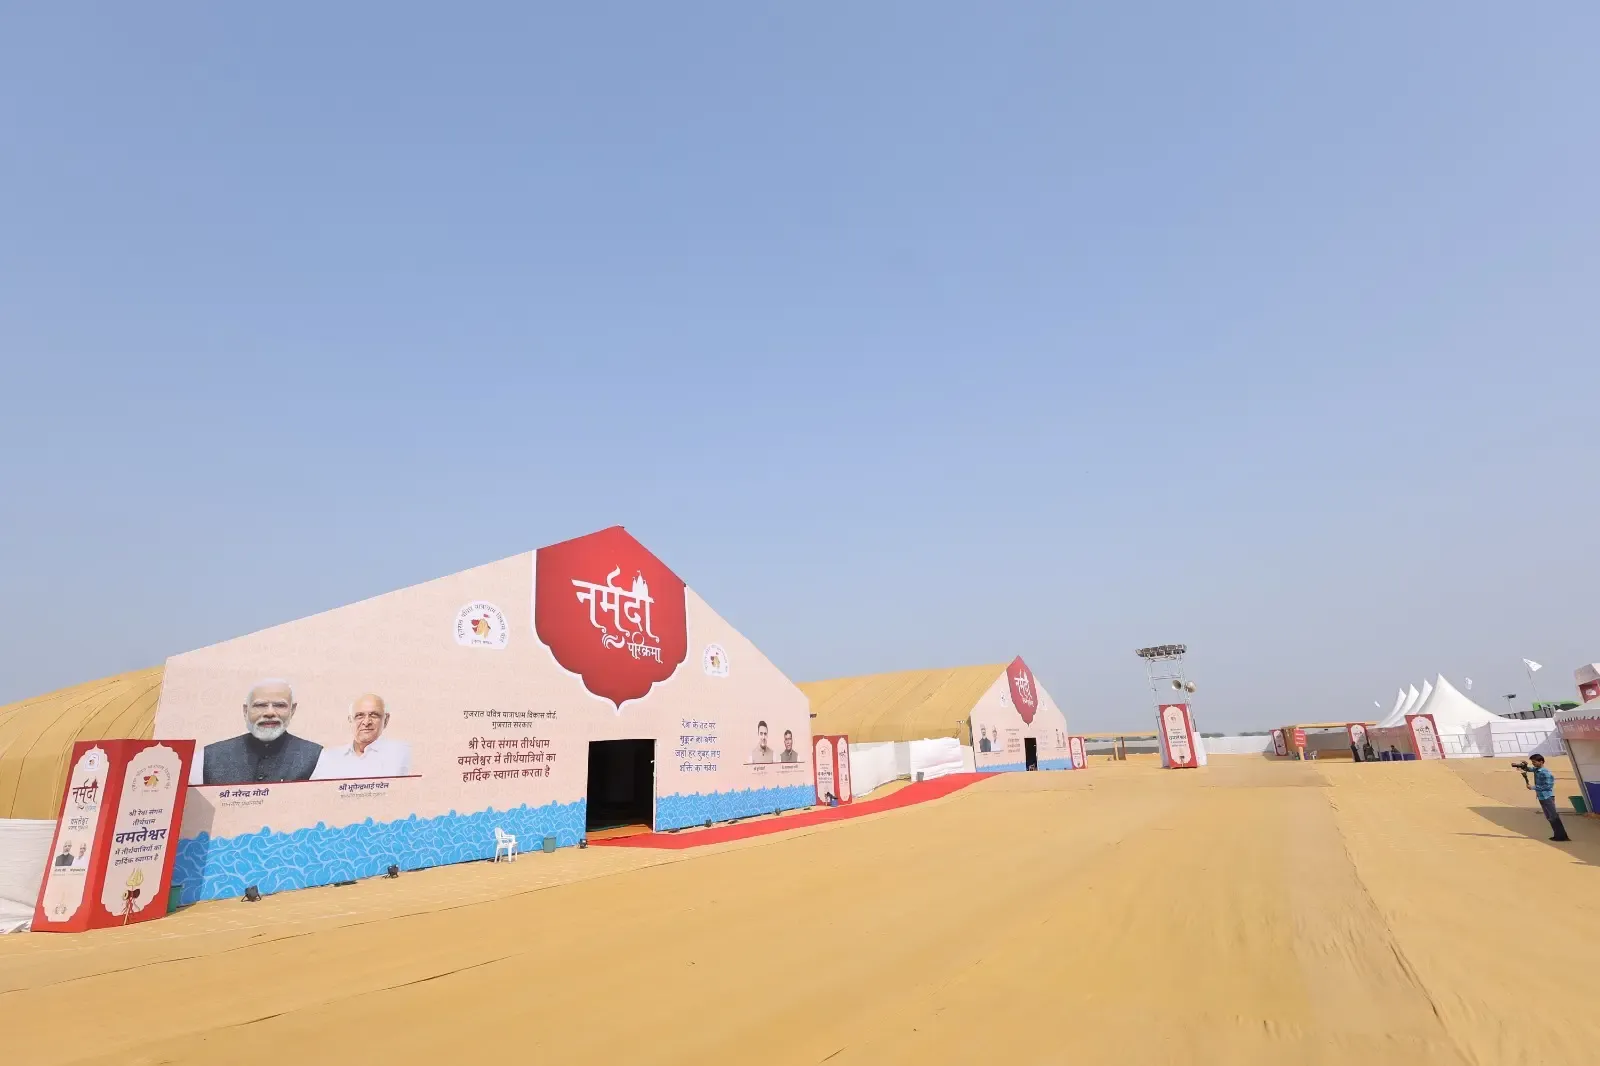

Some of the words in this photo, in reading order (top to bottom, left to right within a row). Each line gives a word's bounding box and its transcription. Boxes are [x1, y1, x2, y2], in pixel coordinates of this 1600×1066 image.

[571, 564, 660, 643] नर्मदा
[627, 632, 663, 664] परिक्रमा
[463, 710, 484, 719] गुजरात
[486, 709, 501, 718] पवित्र
[502, 711, 526, 719] यात्राधाम
[527, 710, 545, 719] विकास
[492, 721, 512, 730] गुजरात
[513, 721, 533, 729] सरकार
[468, 736, 479, 750] श्री
[481, 736, 496, 749] रेवा
[498, 737, 518, 749] संगम
[520, 736, 550, 749] तीर्थधाम
[457, 752, 492, 766] वमलेश्वर
[494, 751, 502, 764] में
[503, 750, 545, 764] तीर्थयात्रियों
[546, 753, 556, 763] का
[462, 768, 491, 783] हार्दिक
[493, 769, 520, 779] स्वागत
[521, 768, 543, 778] करता
[544, 765, 551, 778] है
[219, 789, 230, 798] श्री
[232, 788, 251, 797] नरेन्द्र
[252, 788, 270, 796] मोदी
[339, 783, 347, 791] श्री
[115, 827, 167, 844] वमलेश्वर
